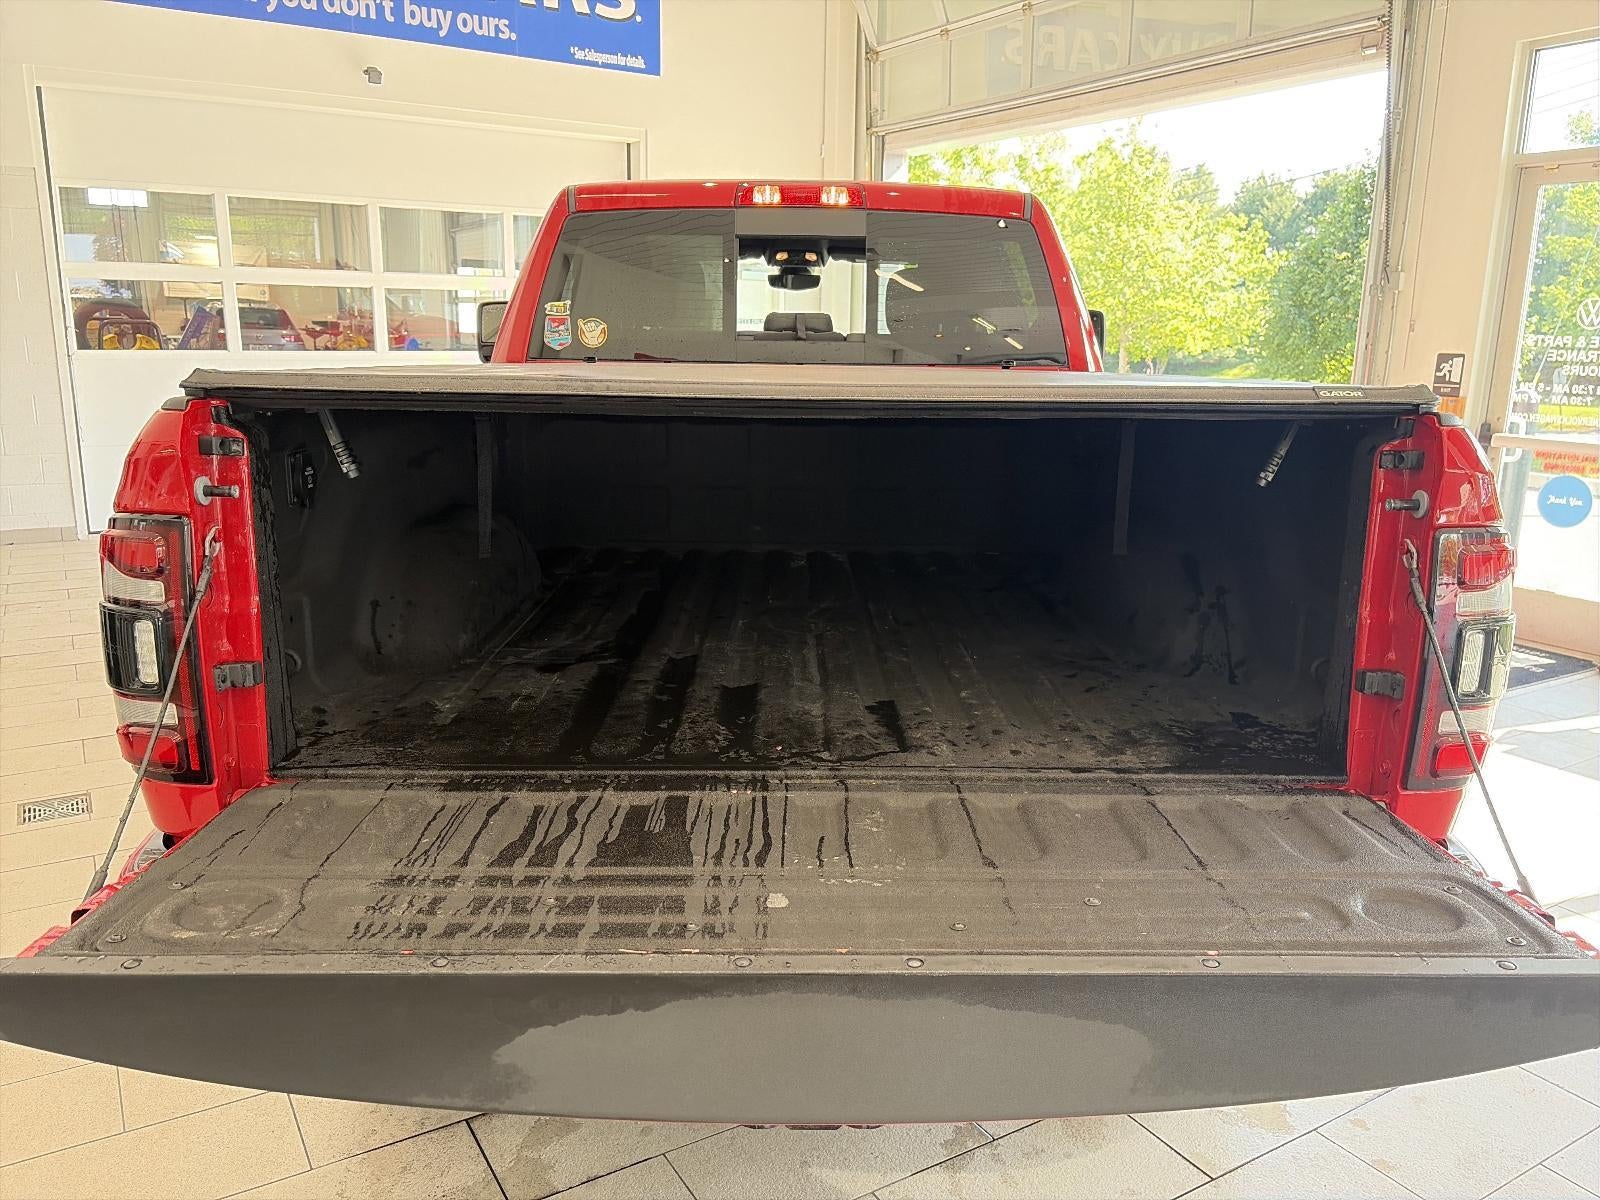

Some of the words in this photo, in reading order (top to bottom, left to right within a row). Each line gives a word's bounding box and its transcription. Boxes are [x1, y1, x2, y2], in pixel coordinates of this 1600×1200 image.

[403, 0, 453, 37] buy
[456, 12, 517, 40] ours.
[584, 48, 618, 65] Salesperson
[618, 52, 626, 65] for
[1546, 494, 1568, 505] Thank
